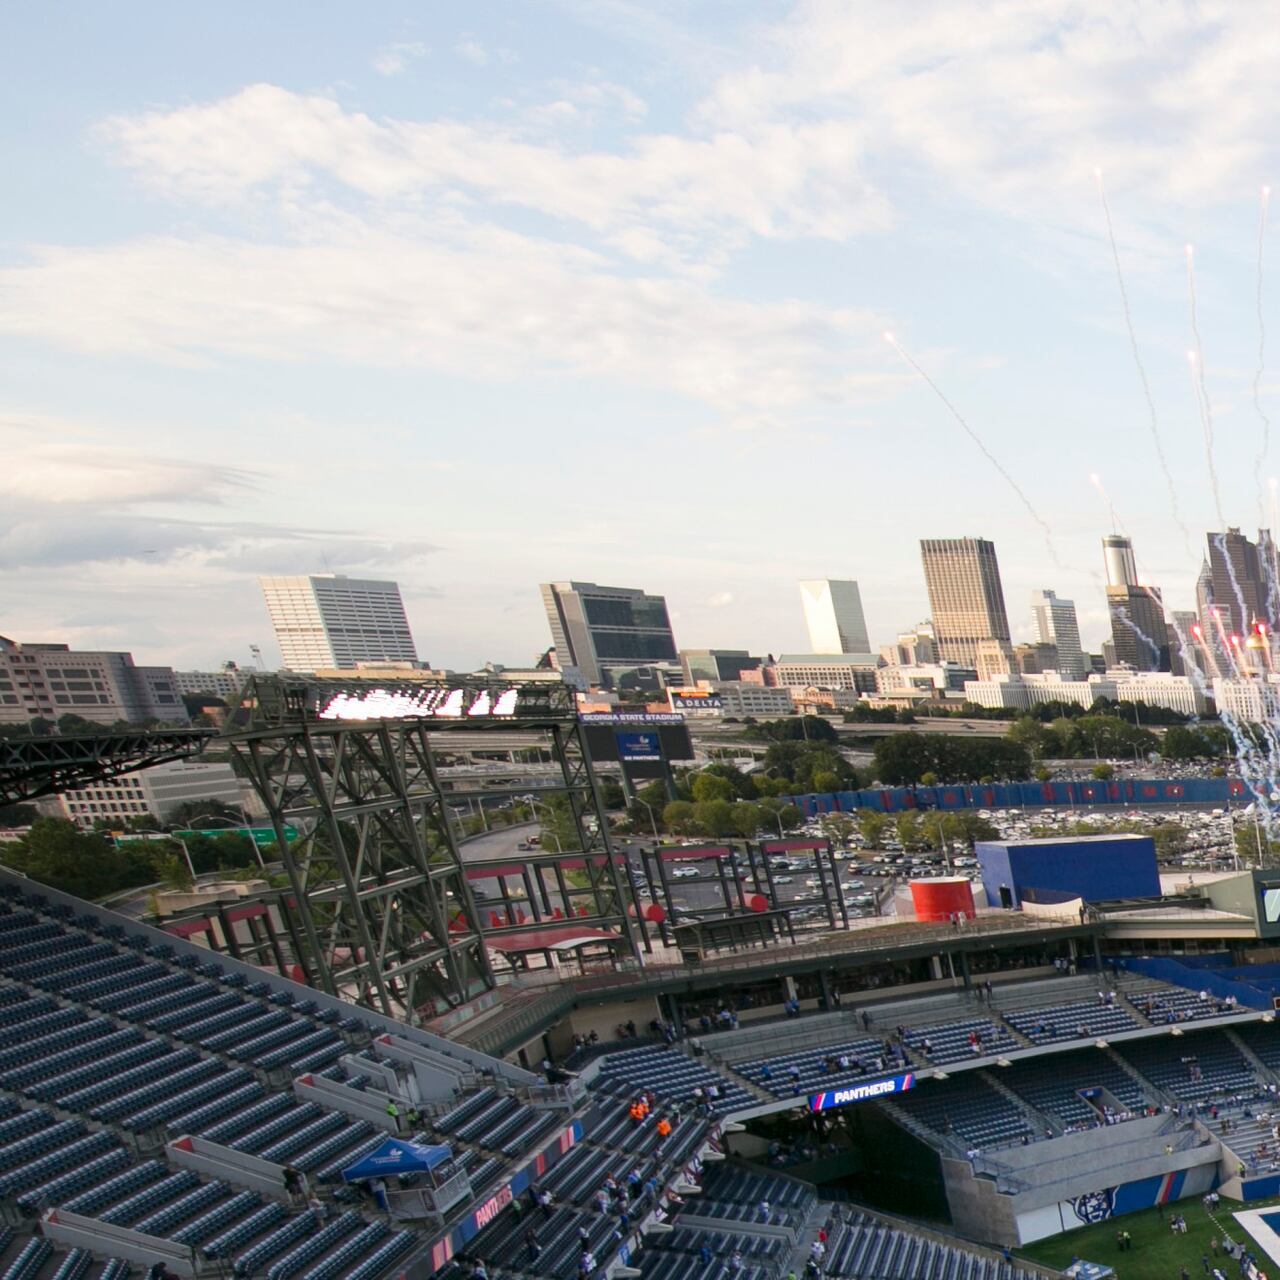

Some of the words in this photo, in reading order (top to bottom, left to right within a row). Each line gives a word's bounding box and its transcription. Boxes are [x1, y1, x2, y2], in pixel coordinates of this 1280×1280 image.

[685, 699, 722, 708] DELTA
[583, 713, 619, 721] GEORGIA
[620, 713, 644, 721] STATE
[645, 713, 683, 721] STADIUM
[834, 1080, 896, 1104] PANTHERS
